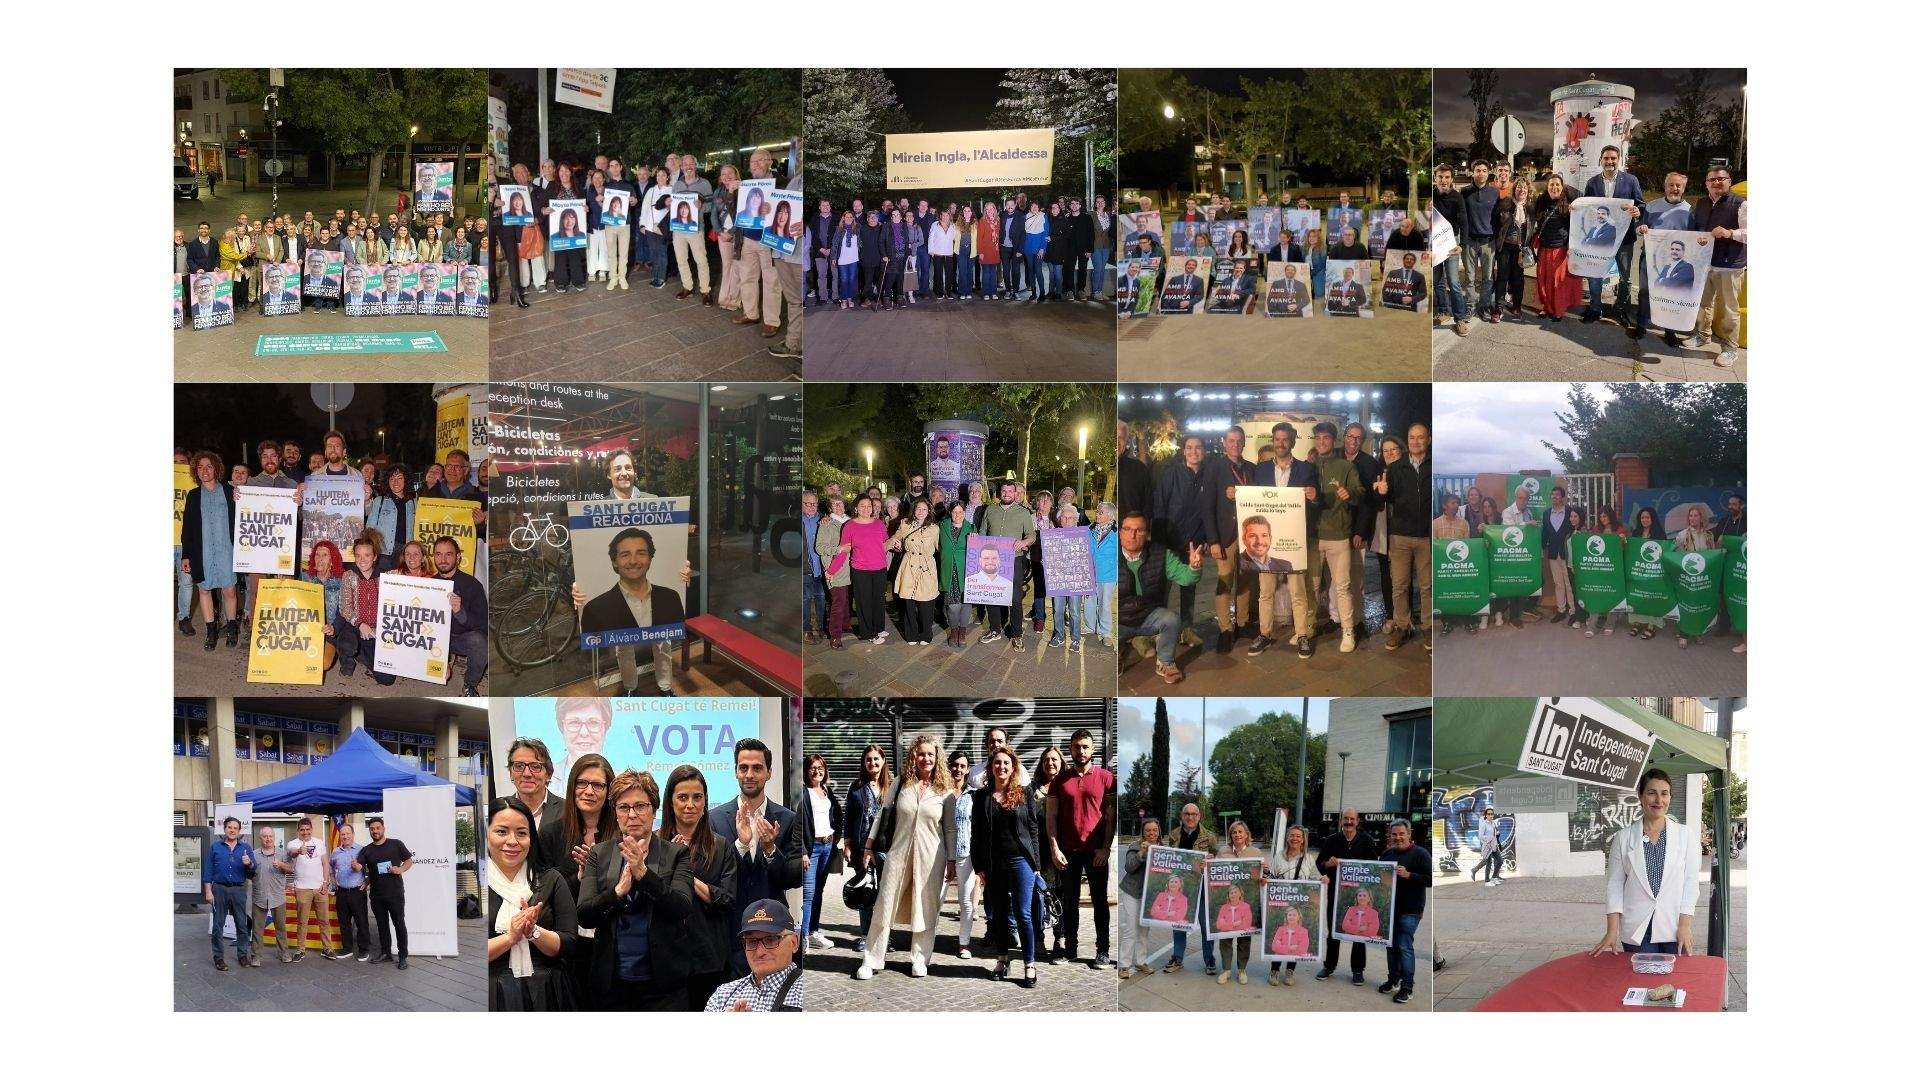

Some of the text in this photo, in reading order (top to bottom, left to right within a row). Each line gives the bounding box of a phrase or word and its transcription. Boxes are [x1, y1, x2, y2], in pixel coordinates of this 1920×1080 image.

[892, 148, 1048, 164] Mireia Ingla, l'Alcaldessa
[529, 382, 609, 400] and routes at the
[540, 398, 564, 410] desk
[472, 426, 487, 436] SA
[494, 425, 560, 441] Bicicletas
[514, 446, 584, 458] condiciones
[506, 476, 560, 488] Bicicletes
[316, 490, 349, 499] LLUITEM
[524, 492, 576, 503] condicions
[580, 492, 582, 500] i
[584, 492, 604, 500] rutes
[1262, 490, 1278, 498] VOX
[304, 498, 360, 506] SANT CUGAT
[582, 500, 677, 516] SANT CUGAT
[240, 512, 292, 526] LLUITEM
[592, 512, 674, 528] REACCIONA
[240, 524, 275, 536] SANT
[419, 522, 472, 538] LLUITEM
[238, 535, 286, 548] CUGAT
[1440, 562, 1474, 570] PACMA
[1635, 561, 1662, 570] PACMA
[258, 607, 320, 622] LLUITEM
[383, 602, 446, 624] LLUITEM
[258, 622, 300, 636] SANT
[382, 617, 423, 634] SANT
[380, 631, 436, 651] CUGAT
[608, 632, 640, 644] Álvaro
[642, 628, 683, 640] Benejam
[256, 635, 312, 651] CUGAT
[616, 700, 757, 714] Sant Cugat té Remei!
[257, 717, 277, 726] Sabat
[285, 720, 303, 730] Sabat
[1535, 708, 1569, 758] In
[634, 724, 736, 756] VOTA
[1578, 722, 1644, 763] Independents
[259, 750, 278, 759] Sabat
[286, 752, 304, 760] Sabat
[1528, 756, 1563, 772] SANT CUGAT
[1571, 749, 1627, 782] Sant Cugat
[1154, 852, 1182, 862] gente
[1153, 860, 1192, 871] valiente
[1210, 865, 1239, 874] gente
[1342, 866, 1370, 875] gente
[1210, 872, 1250, 880] valiente
[1342, 874, 1381, 883] valiente
[1270, 885, 1298, 894] gente
[1269, 893, 1309, 902] valiente
